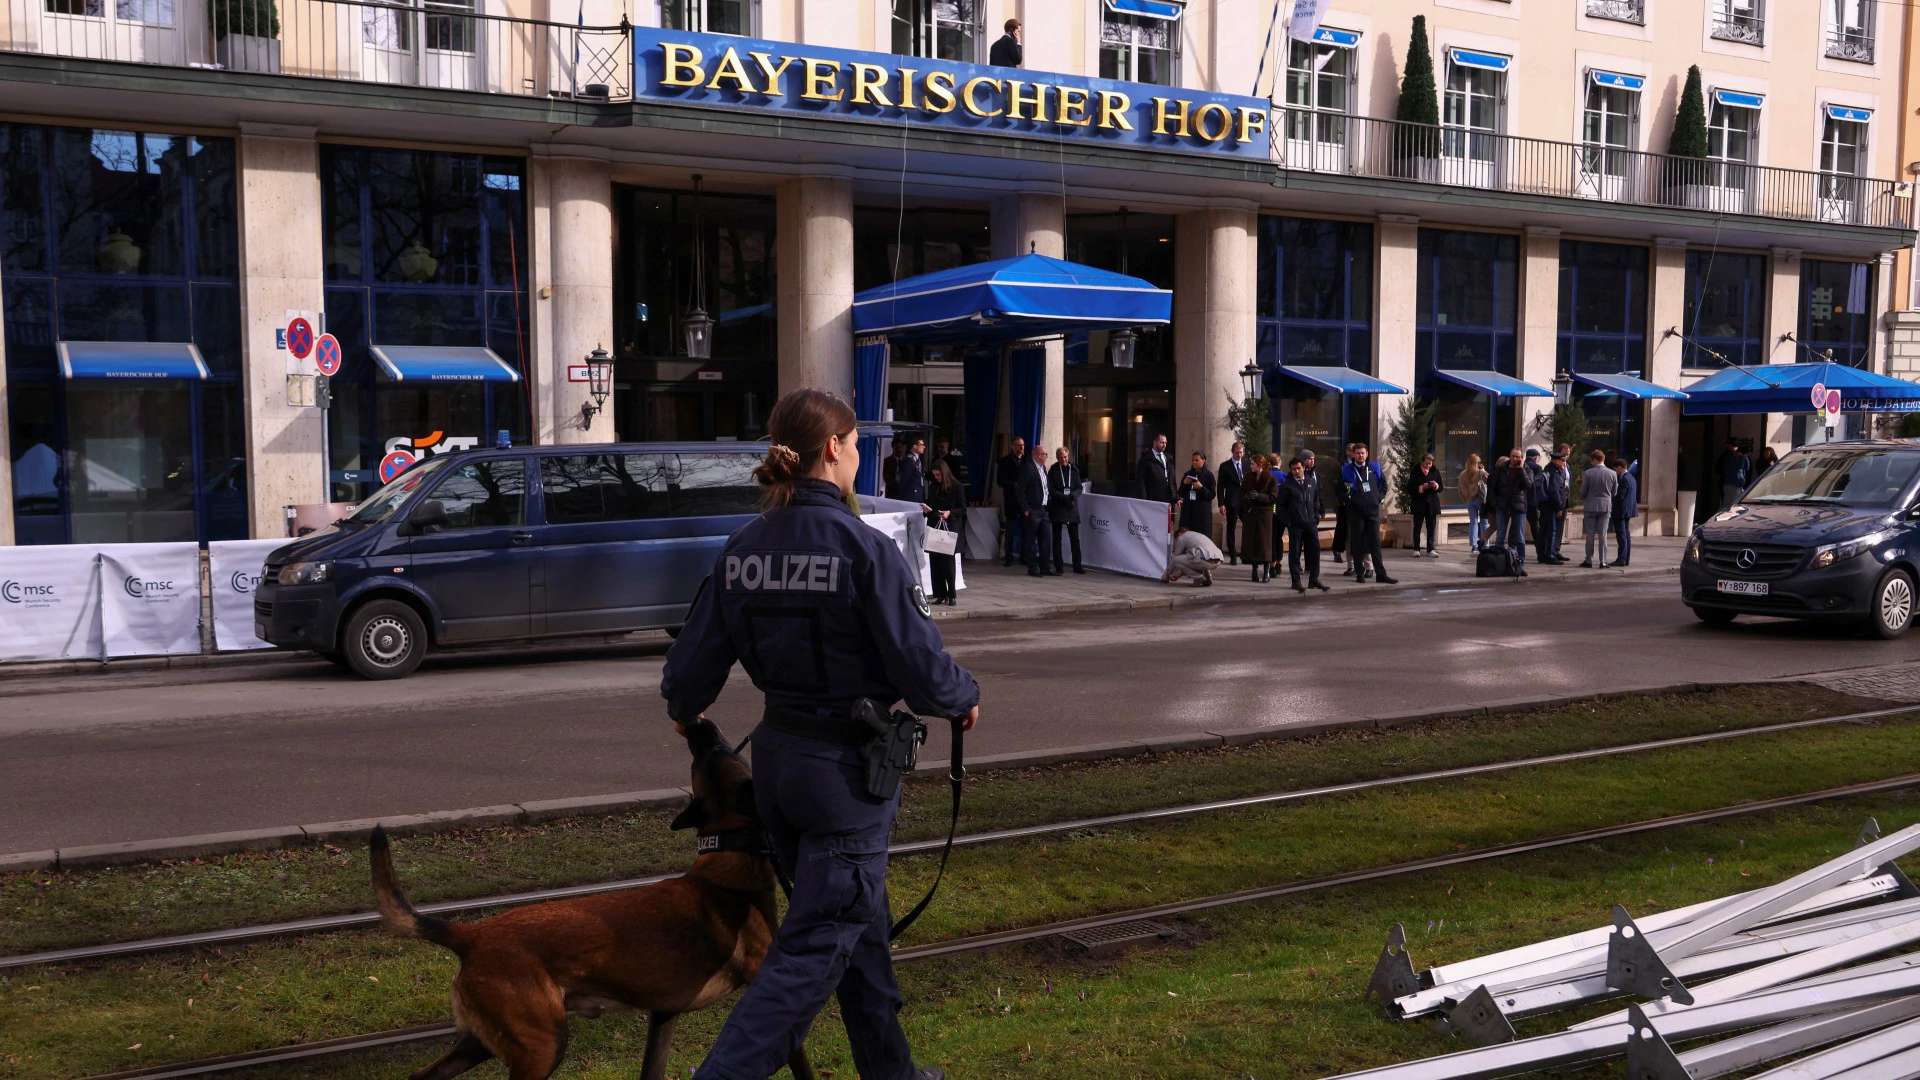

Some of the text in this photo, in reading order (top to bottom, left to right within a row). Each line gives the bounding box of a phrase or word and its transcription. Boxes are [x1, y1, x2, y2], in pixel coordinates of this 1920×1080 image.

[658, 41, 1266, 143] BAYERISCHER HOF
[1840, 398, 1881, 409] HOTEL
[1097, 519, 1110, 527] msc
[1135, 524, 1148, 533] msc
[725, 554, 840, 592] POLIZEI
[24, 585, 55, 595] msc
[145, 580, 174, 590] msc
[1723, 581, 1768, 593] Y 897 168
[697, 835, 719, 850] LIZEI
